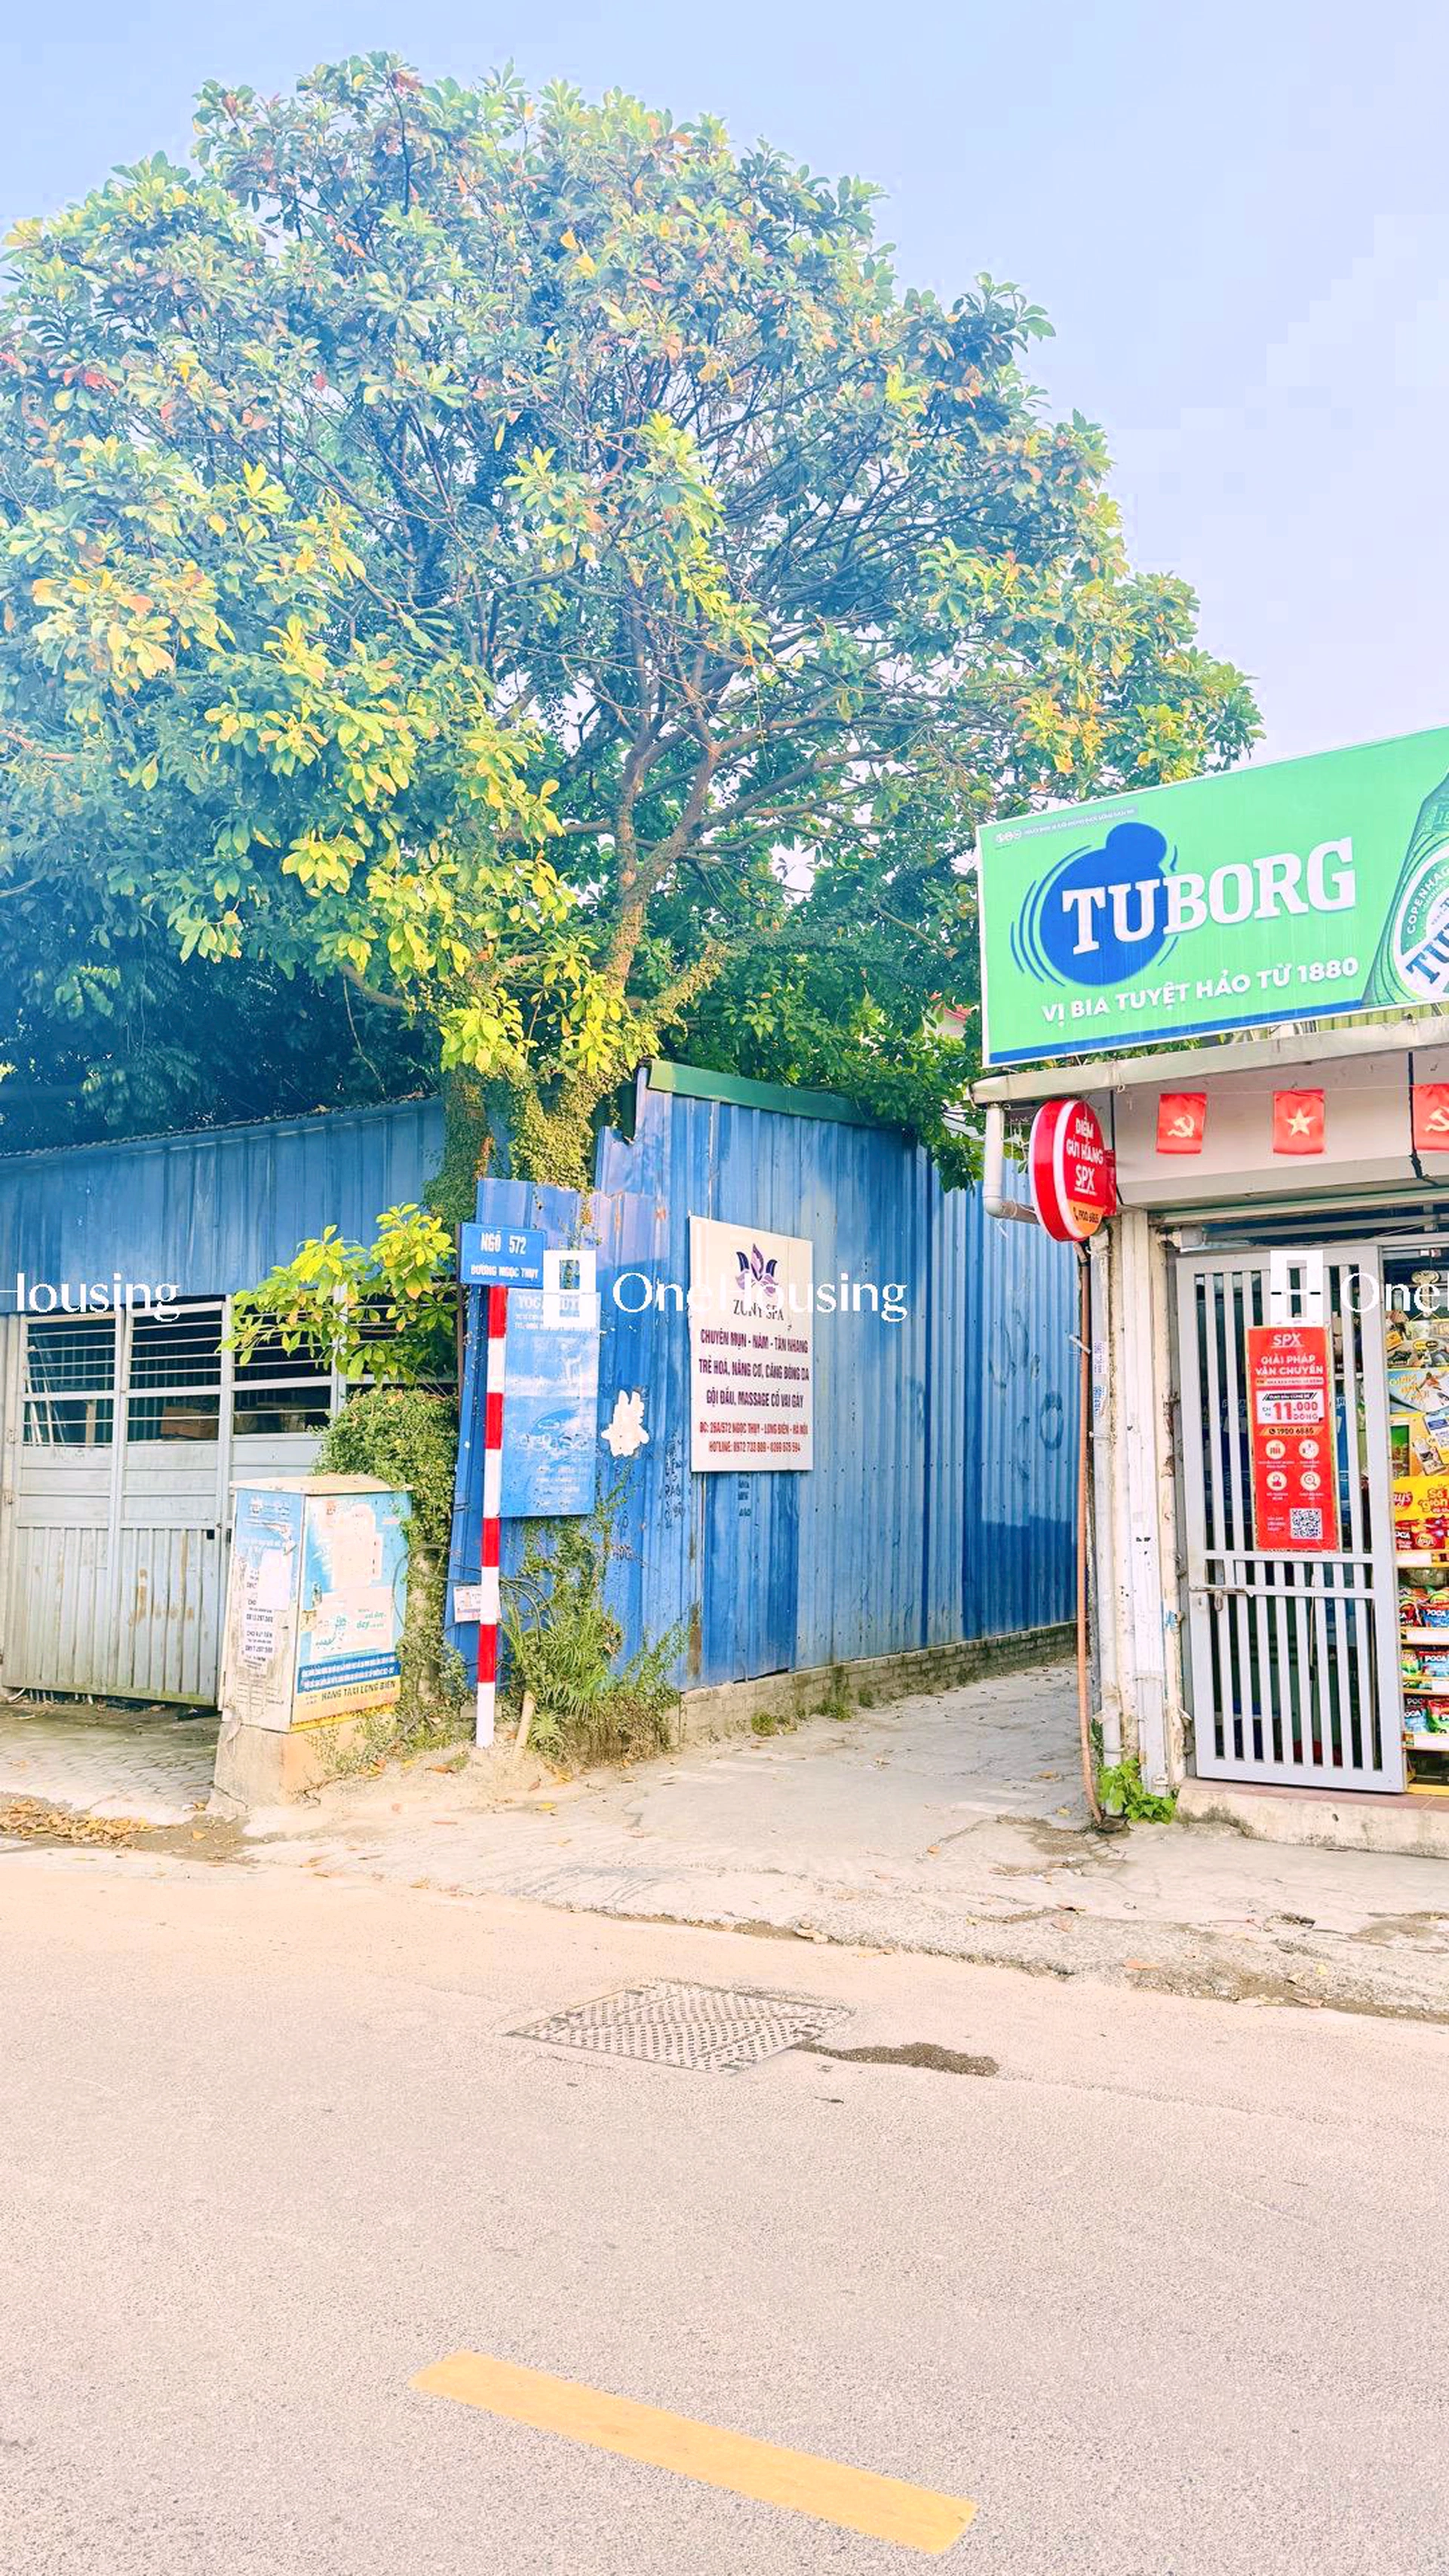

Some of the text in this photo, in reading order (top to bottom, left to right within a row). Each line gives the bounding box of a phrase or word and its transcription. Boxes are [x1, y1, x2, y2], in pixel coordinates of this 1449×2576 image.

[1062, 837, 1355, 955] TUBORG
[1042, 956, 1358, 1026] VỊ BIA TUYỆT HẢO TỪ 1880
[1075, 1165, 1095, 1190] SPX
[480, 1230, 527, 1254] NGÕ 572
[700, 1328, 729, 1345] CHUYÊN
[787, 1338, 808, 1353] NHANG
[1272, 1333, 1301, 1346] SPX
[1279, 1363, 1323, 1375] CHUYỂN
[1287, 1353, 1315, 1364] PHÁP
[738, 1391, 769, 1408] MASSAGE
